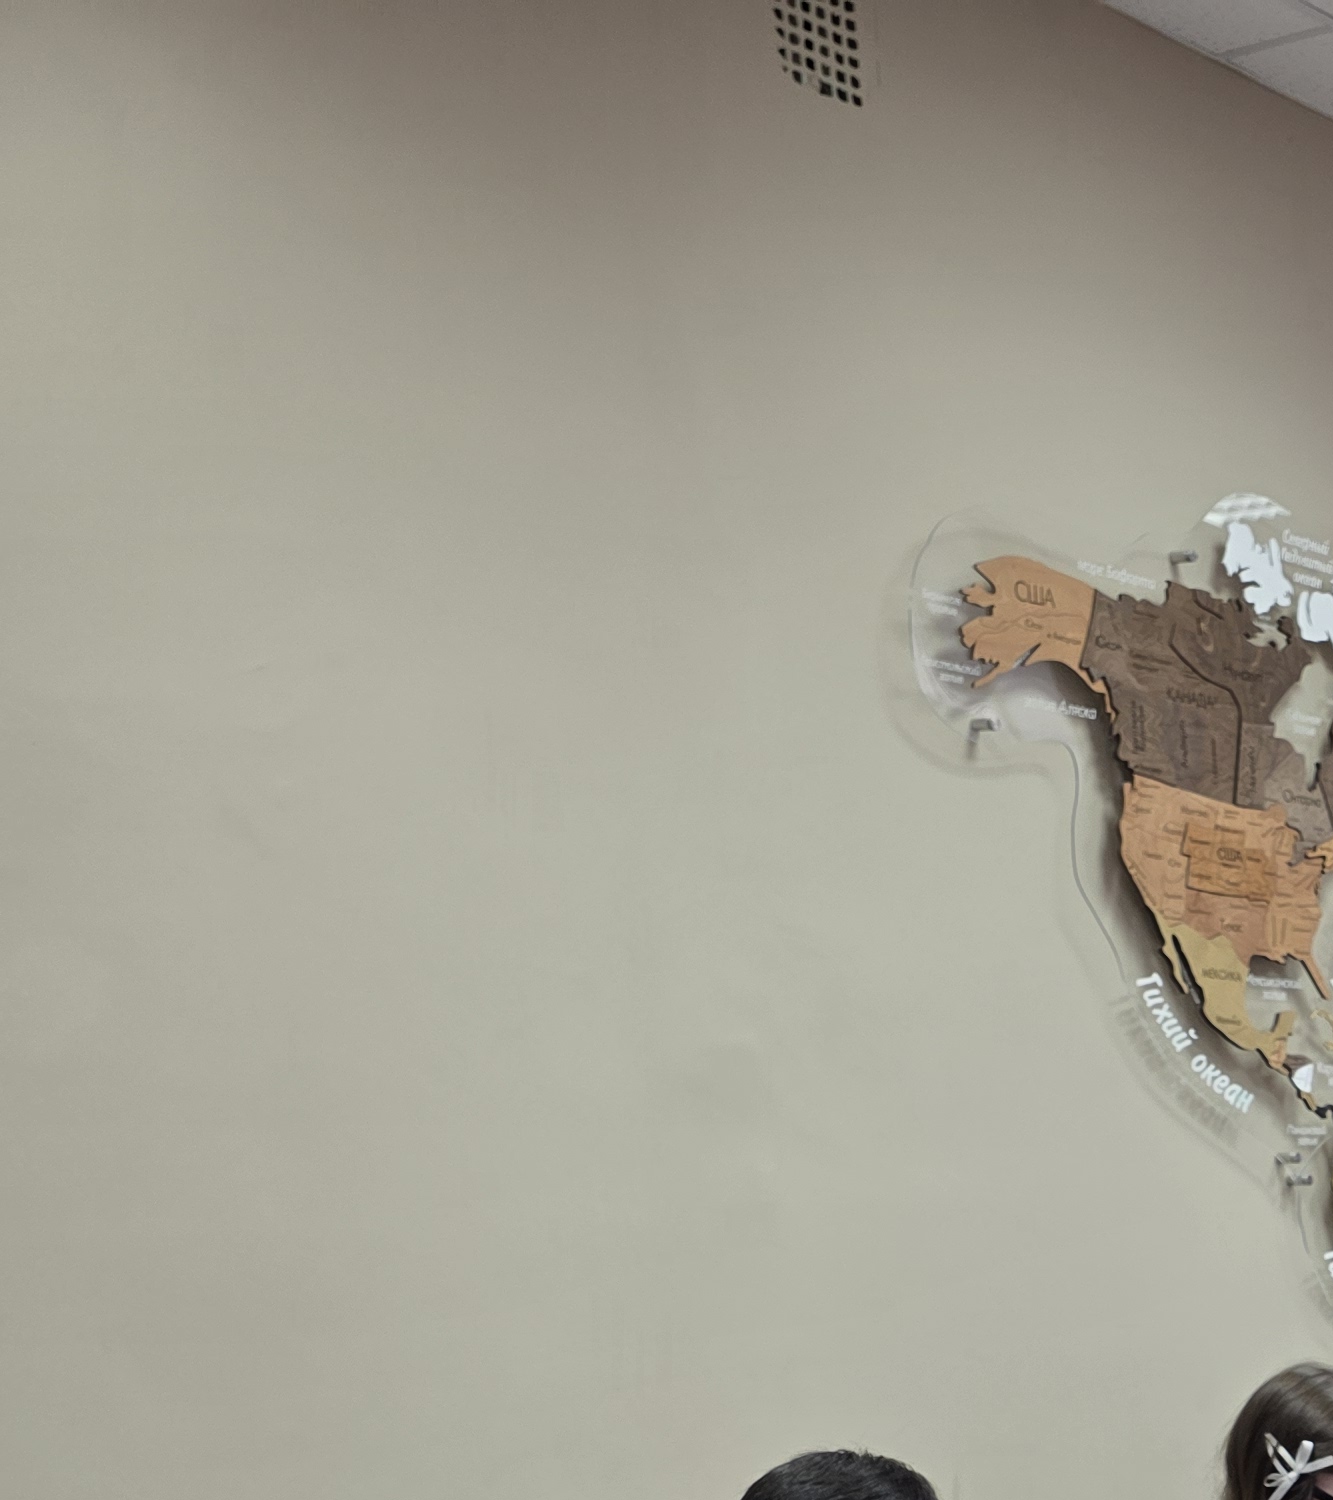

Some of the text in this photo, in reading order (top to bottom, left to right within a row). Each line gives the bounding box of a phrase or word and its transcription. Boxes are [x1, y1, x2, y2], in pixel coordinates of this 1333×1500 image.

[1014, 580, 1056, 608] США
[1136, 973, 1255, 1113] Тихий океан
